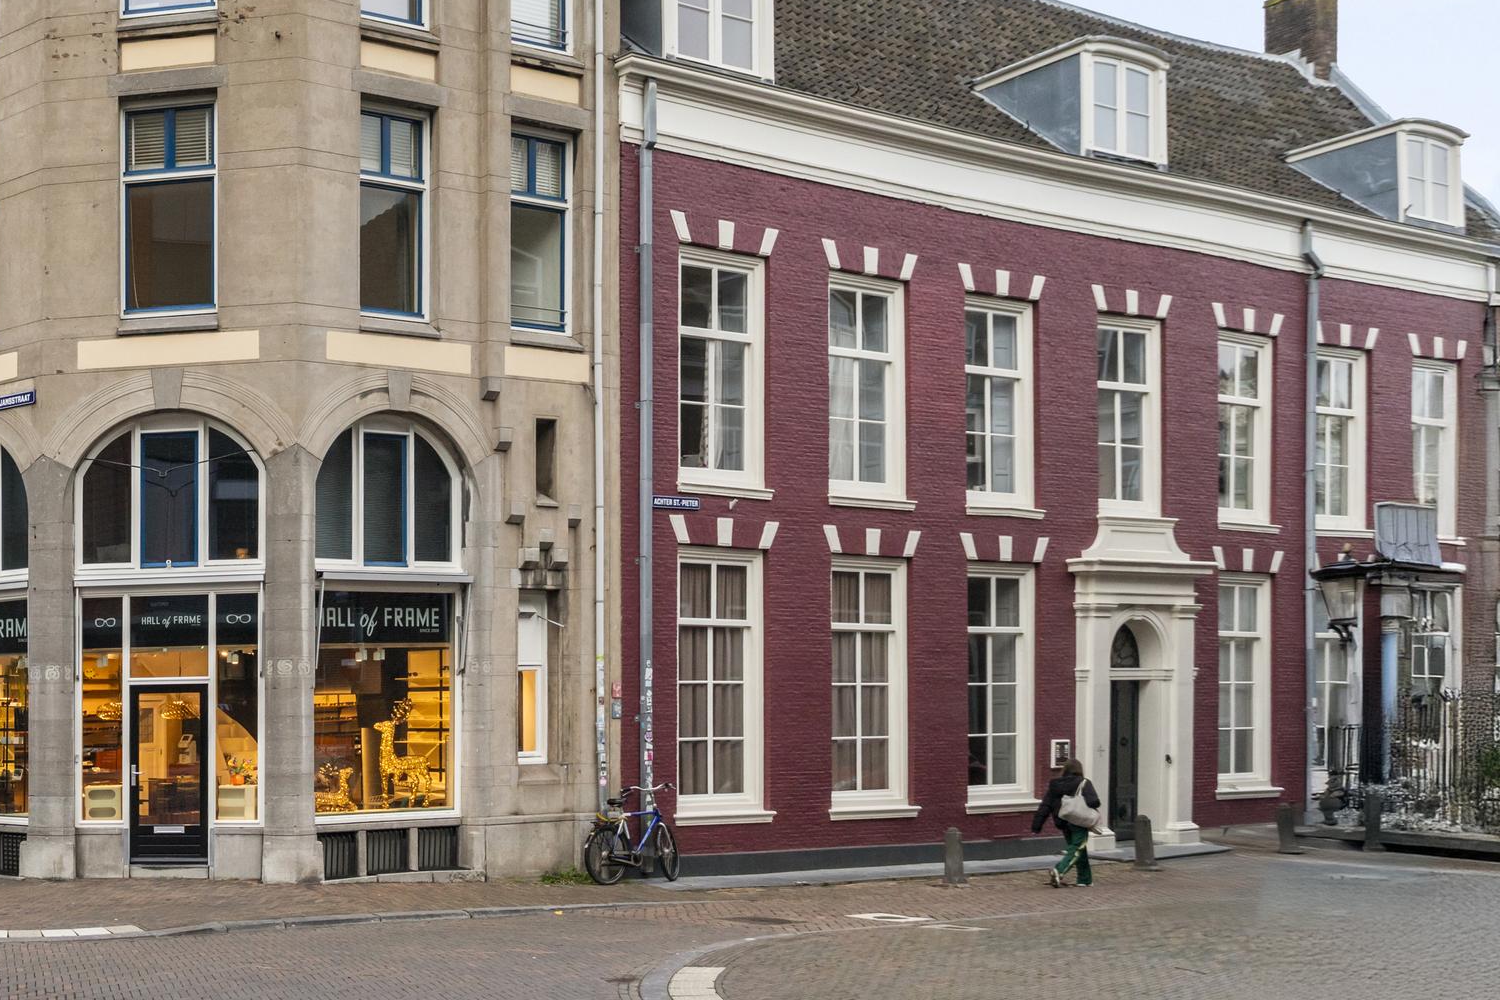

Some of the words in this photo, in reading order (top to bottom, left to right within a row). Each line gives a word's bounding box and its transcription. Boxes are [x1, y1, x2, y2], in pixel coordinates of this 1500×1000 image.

[0, 394, 31, 407] JANSSTRAAT
[141, 616, 160, 625] HALL
[162, 615, 172, 629] of
[173, 615, 202, 625] FRAME
[360, 606, 378, 637] of
[384, 607, 439, 627] FRAME
